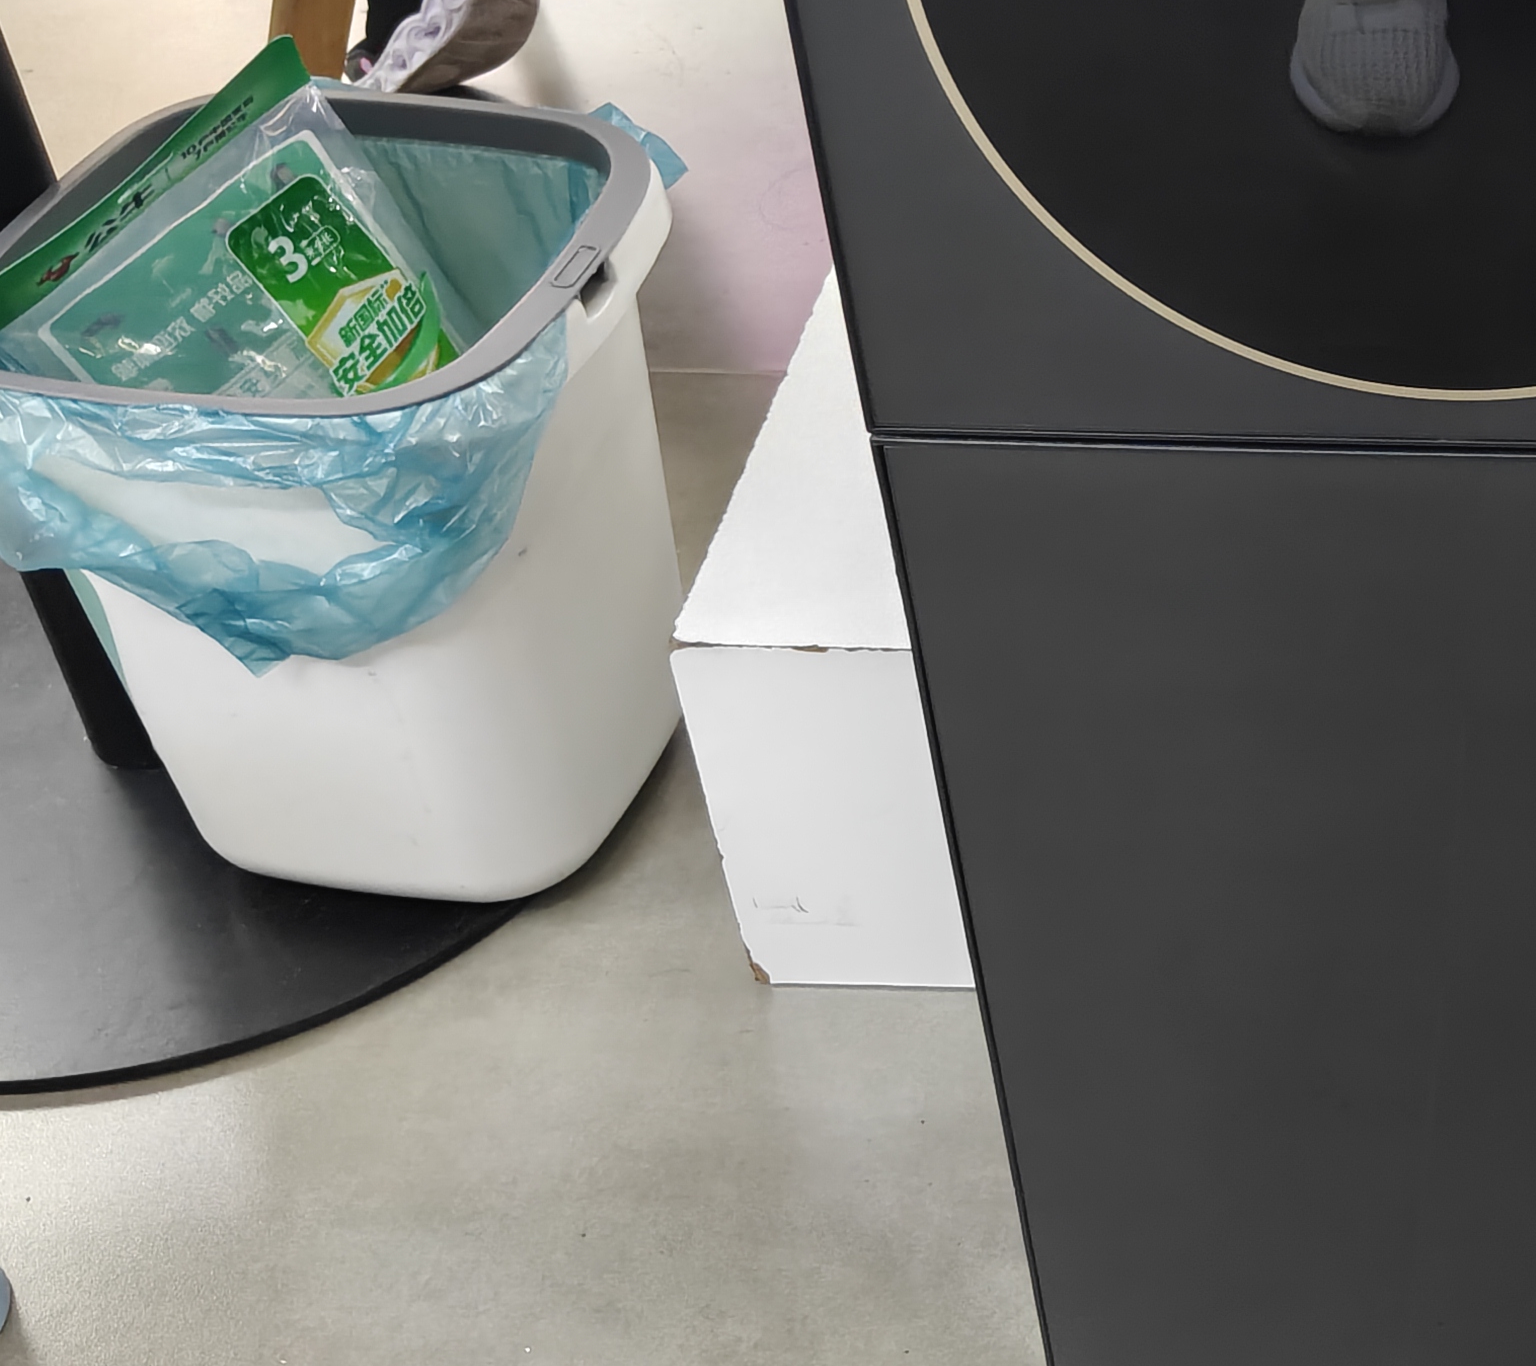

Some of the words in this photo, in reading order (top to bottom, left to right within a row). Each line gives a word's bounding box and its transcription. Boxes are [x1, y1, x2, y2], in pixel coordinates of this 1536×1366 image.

[268, 236, 309, 283] 3
[331, 282, 427, 392] 安全加倍
[339, 287, 389, 349] 新国标
